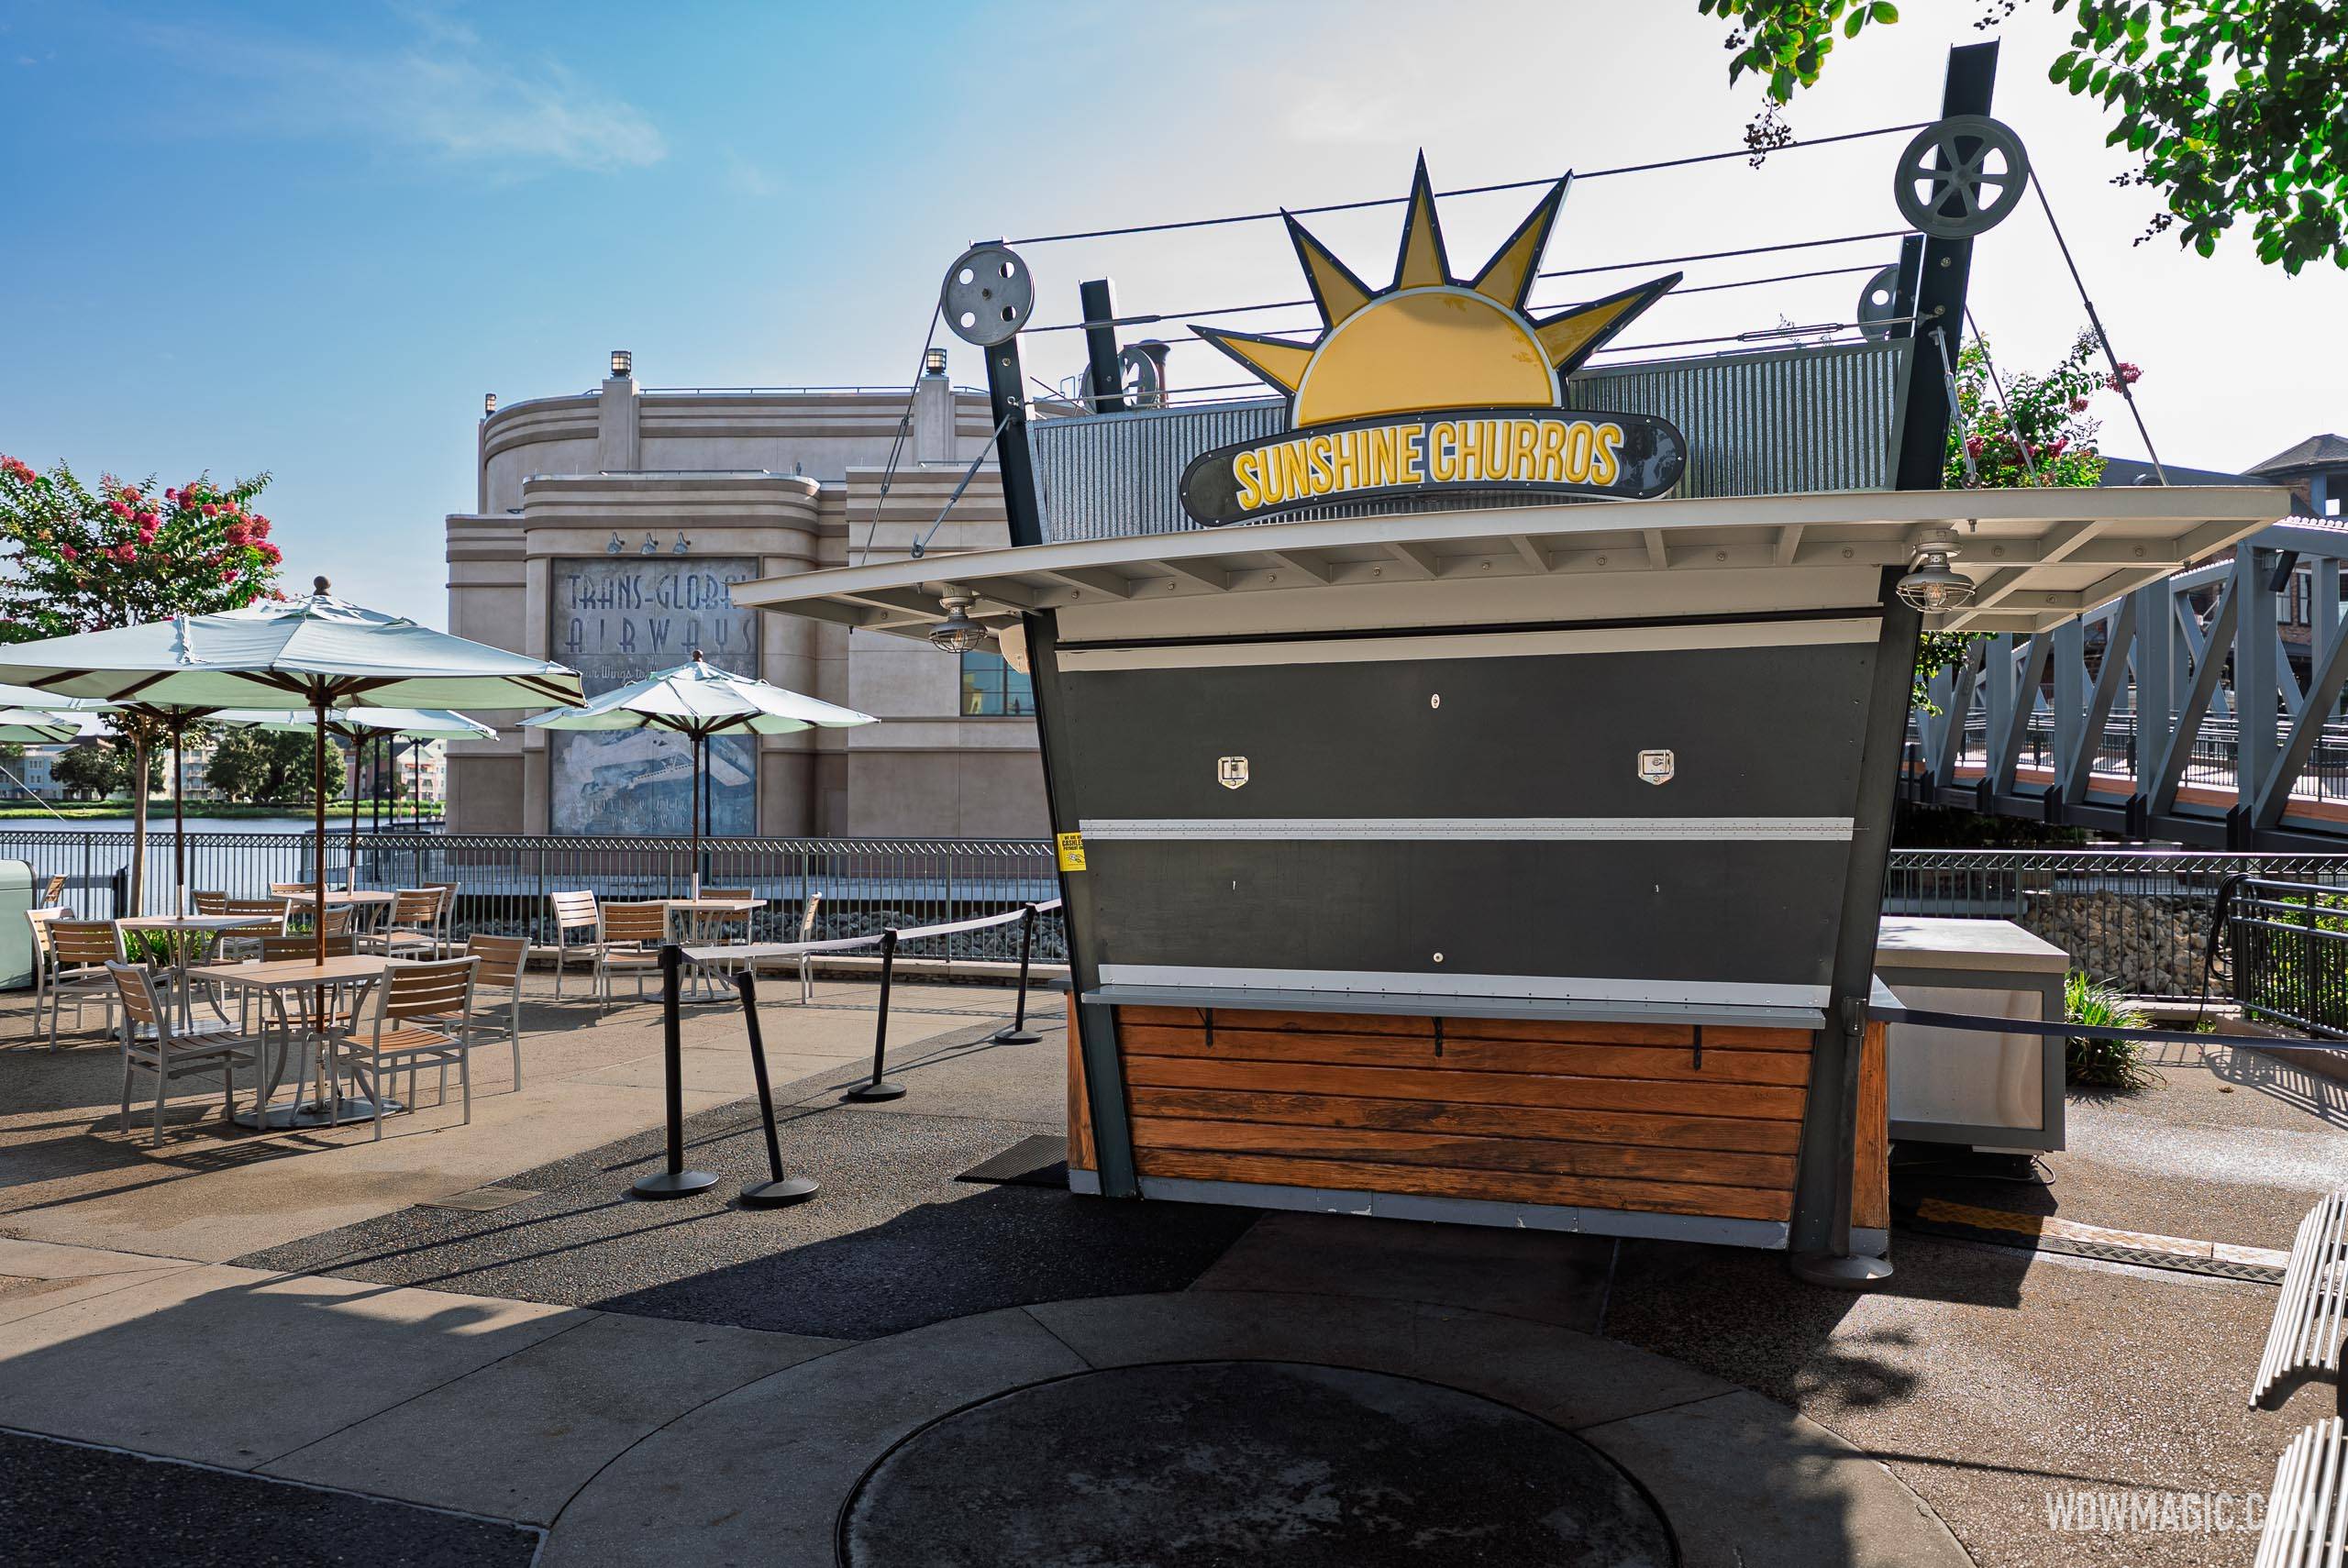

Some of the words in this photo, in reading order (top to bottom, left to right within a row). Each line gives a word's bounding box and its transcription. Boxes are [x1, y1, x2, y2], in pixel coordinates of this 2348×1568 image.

[1234, 425, 1424, 510] SUNSHINE
[1430, 420, 1623, 486] CHURROS
[567, 574, 748, 610] TRANS-GLOBA
[565, 616, 751, 654] AIRWAYS
